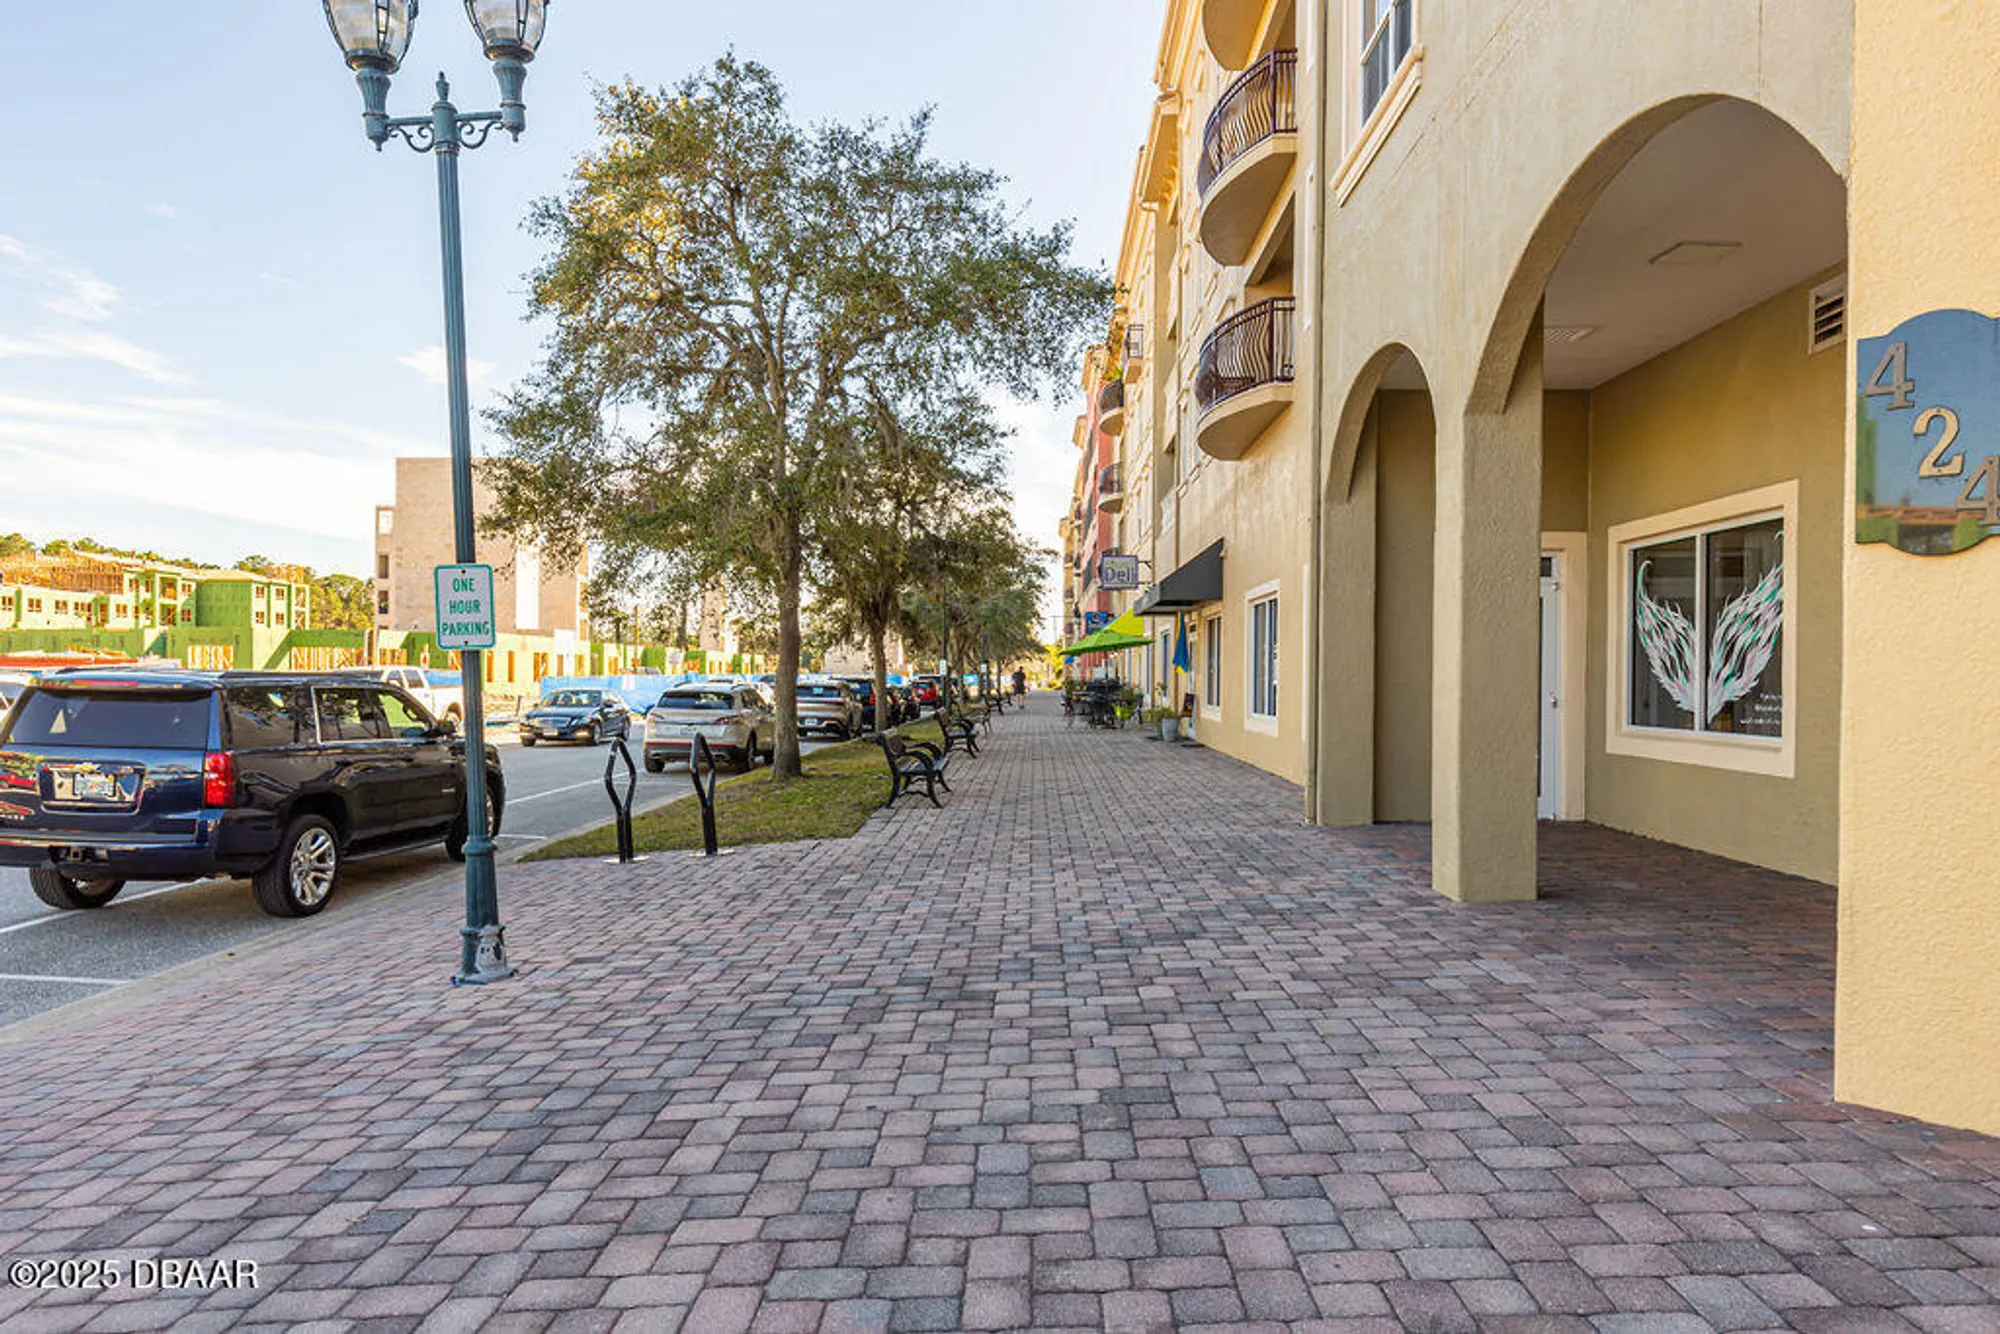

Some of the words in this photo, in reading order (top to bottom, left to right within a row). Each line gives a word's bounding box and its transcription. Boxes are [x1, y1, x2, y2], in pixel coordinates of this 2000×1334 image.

[1865, 341, 2000, 527] 424
[452, 578, 476, 592] ONE
[449, 599, 481, 614] HOUR
[441, 621, 489, 636] PARKING
